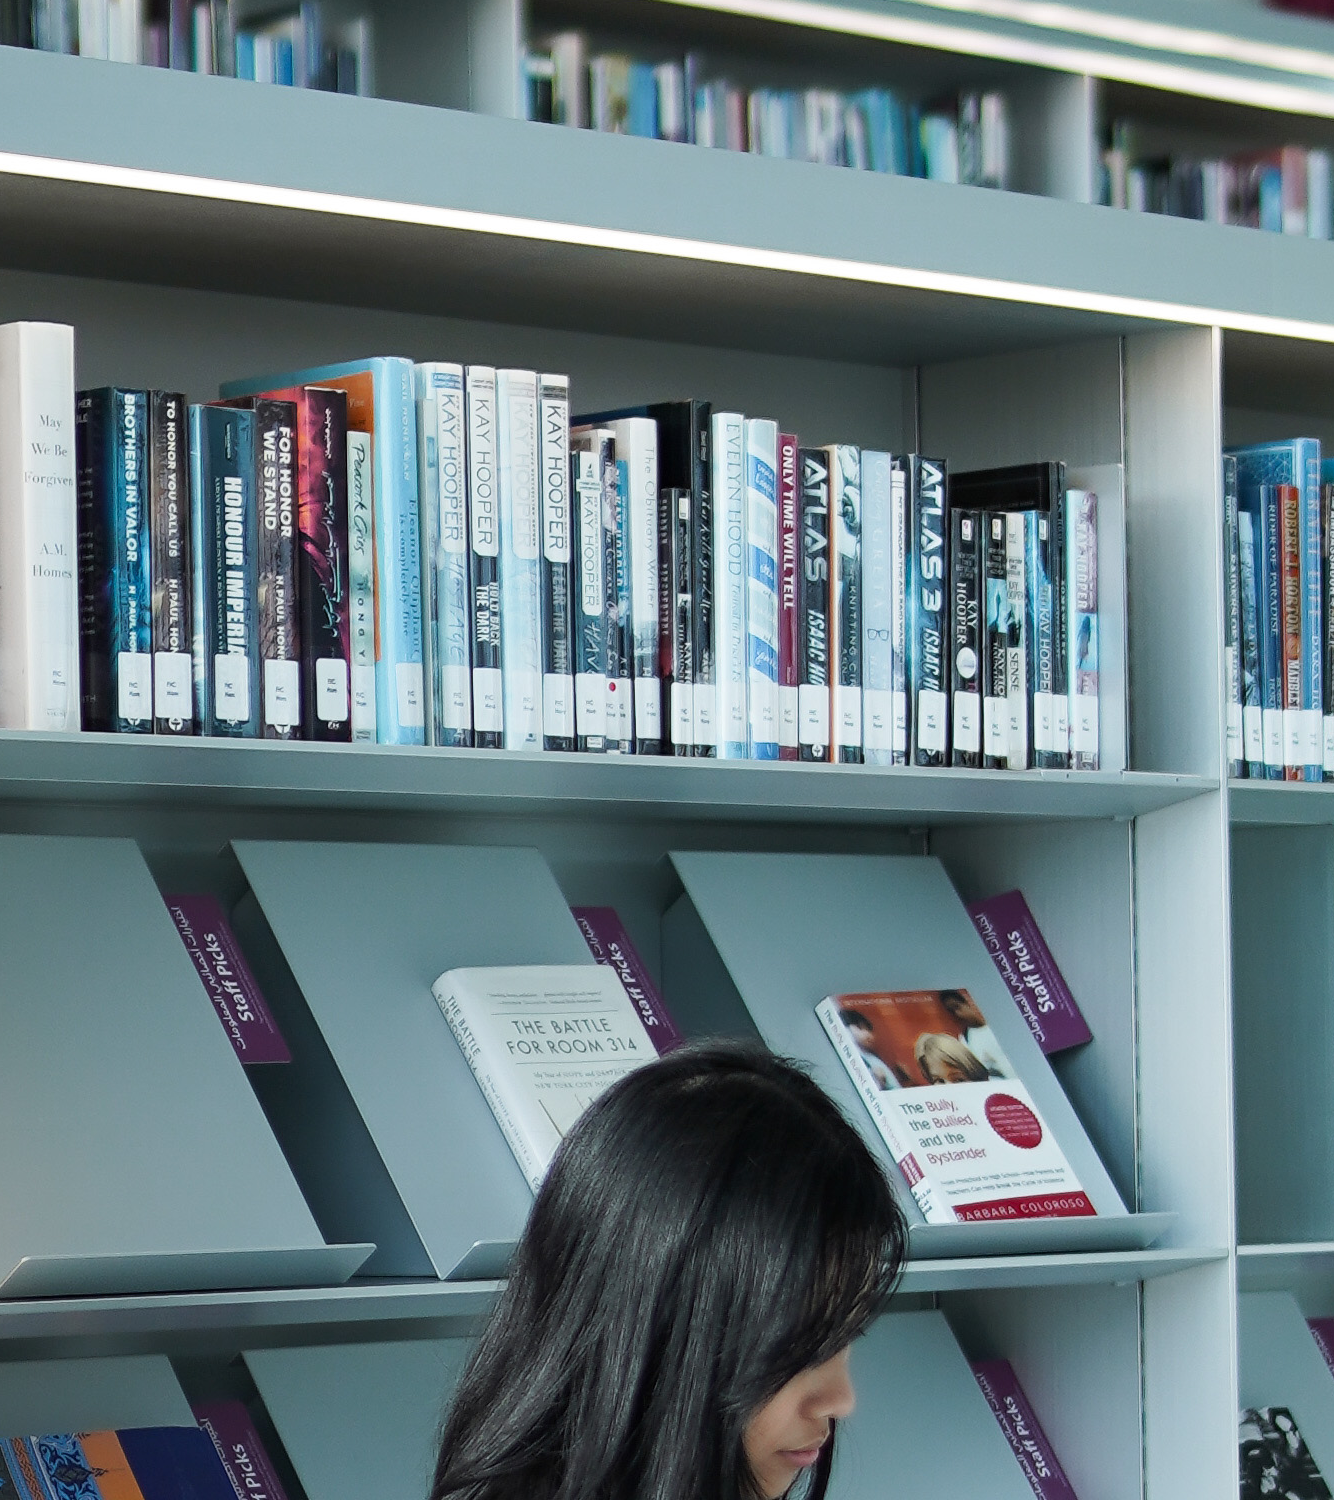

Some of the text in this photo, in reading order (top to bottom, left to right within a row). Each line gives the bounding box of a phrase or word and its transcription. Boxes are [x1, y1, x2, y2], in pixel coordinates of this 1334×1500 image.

[442, 394, 456, 438] KAY
[125, 394, 138, 561] BROTHERS IN VALOR
[167, 401, 178, 557] TO HONOR YOU CALL US
[264, 431, 276, 530] WE STAND
[280, 426, 292, 537] FOR HONOR
[443, 446, 459, 540] HOOPER
[476, 399, 492, 545] KAY HOOPER
[548, 405, 564, 550] KAY HOOPER
[224, 476, 243, 565] HONOUR
[727, 509, 741, 575] HOOD
[782, 446, 794, 610] ONLY TIME WILL TELL
[804, 457, 828, 581] ATLAS
[920, 460, 942, 611] ATLAS 3
[585, 535, 595, 606] HOOPER
[476, 585, 489, 642] THE DARK
[957, 582, 967, 644] HOOPER
[967, 600, 977, 629] KAY
[204, 933, 254, 1022] Staff Picks
[608, 942, 658, 1026] Staff Picks
[1007, 931, 1055, 1013] Staff Picks
[506, 1037, 637, 1055] FOR ROOM 314
[513, 1018, 612, 1035] THE BATTLE
[900, 1102, 924, 1116] The
[908, 1119, 930, 1132] the
[919, 1131, 966, 1148] and the
[926, 1148, 987, 1166] Bystander
[955, 1198, 1085, 1222] BARBARA COLOROSO
[232, 1444, 262, 1489] Picks
[1004, 1396, 1051, 1479] Staff Picks
